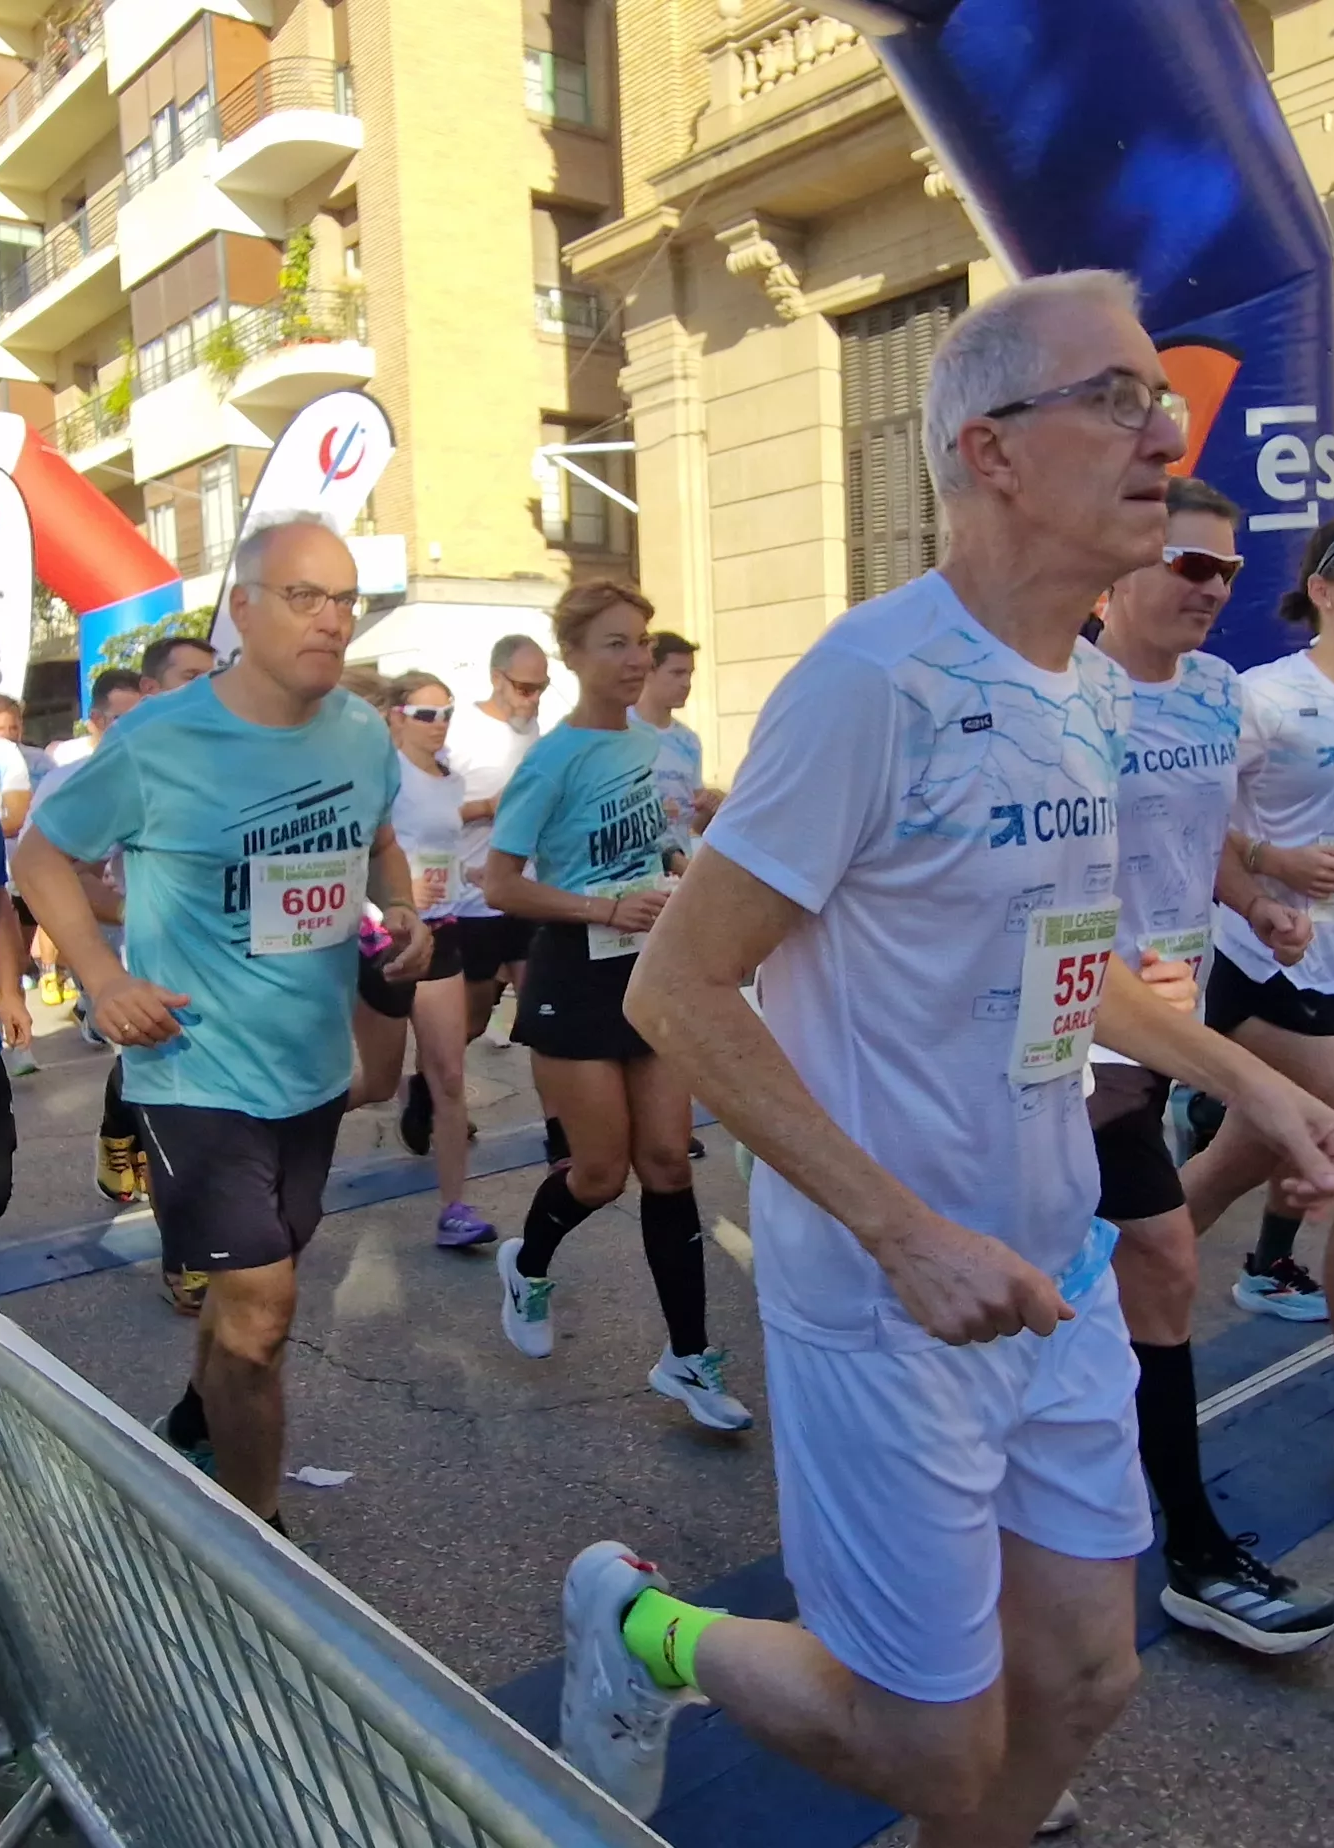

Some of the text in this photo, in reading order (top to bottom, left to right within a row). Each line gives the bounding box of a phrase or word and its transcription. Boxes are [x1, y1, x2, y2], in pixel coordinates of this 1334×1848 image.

[270, 806, 338, 847] CARRERA
[589, 798, 667, 868] EMPRESA
[281, 883, 346, 916] 600
[297, 915, 333, 930] PEPE
[292, 932, 313, 947] 8K
[1053, 950, 1112, 1006] 557
[1053, 1005, 1100, 1036] CARLO
[1055, 1035, 1076, 1063] 8K
